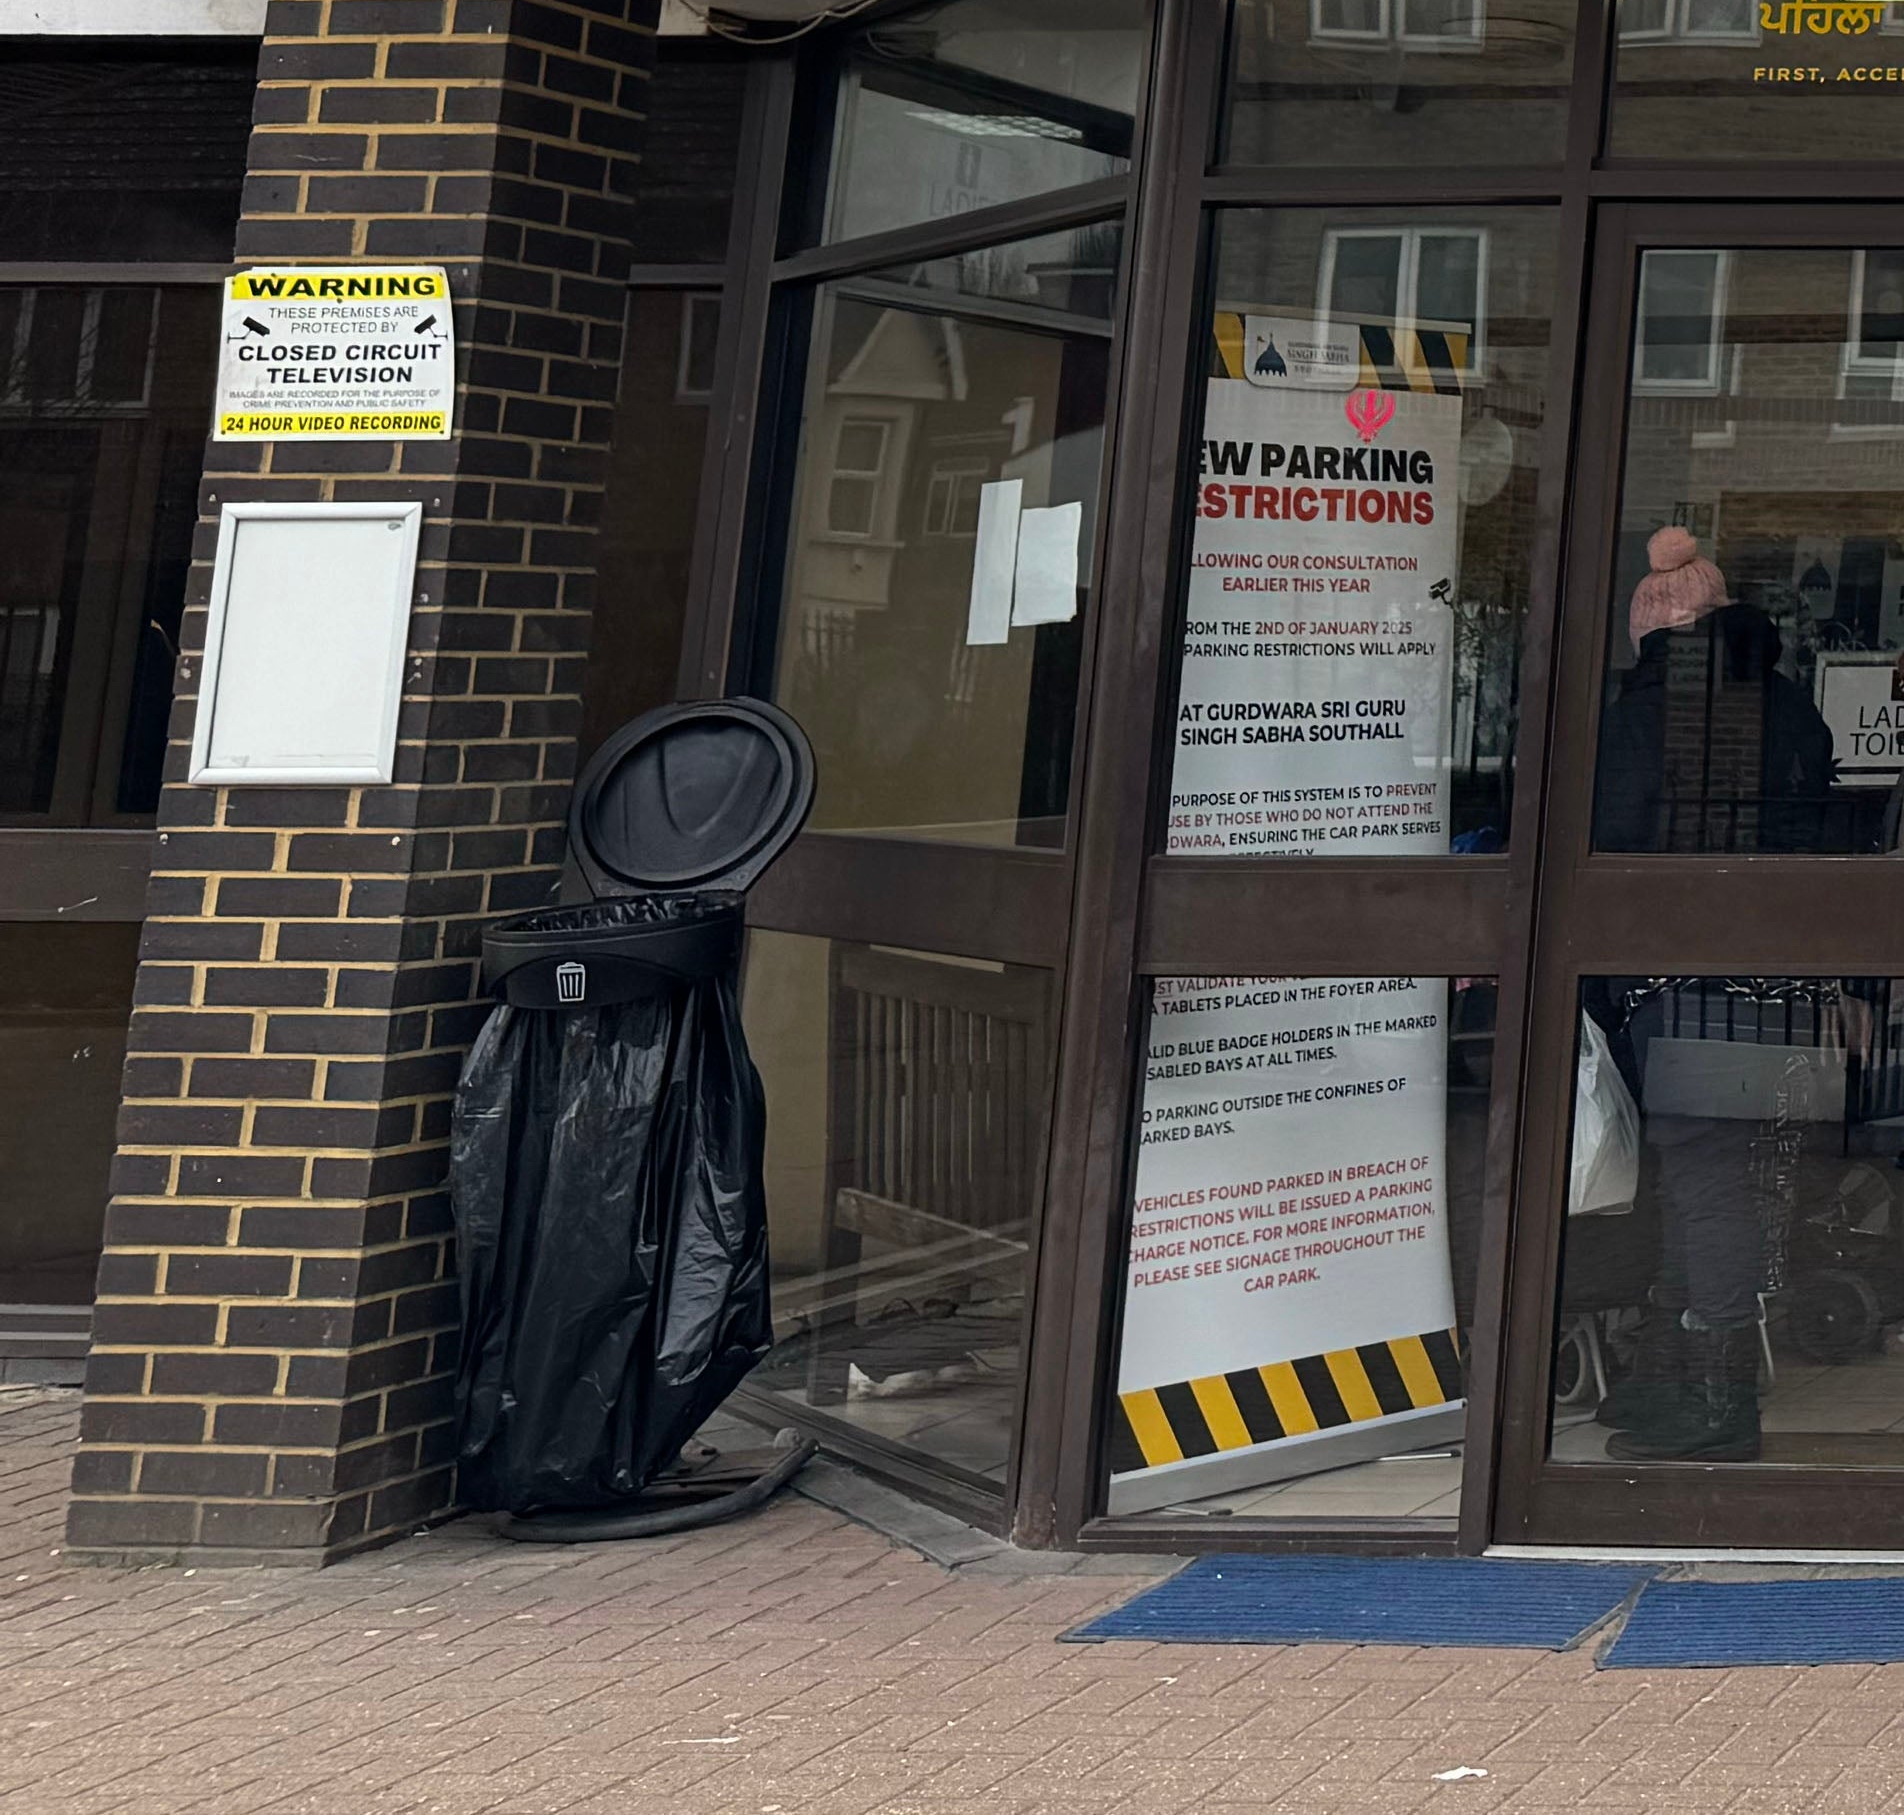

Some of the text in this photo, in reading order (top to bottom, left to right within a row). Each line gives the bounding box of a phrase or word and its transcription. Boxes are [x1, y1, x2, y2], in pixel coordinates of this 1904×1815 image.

[1753, 67, 1826, 84] FIRST,
[247, 276, 436, 297] WARNING
[268, 306, 419, 319] THESE PREMISES ARE
[290, 321, 400, 334] PROTECTED BY
[237, 344, 442, 361] CLOSED CIRCUIT
[266, 366, 413, 384] TELEVISION
[226, 415, 442, 431] 24 HOUR VIDEO RECORDING
[1260, 442, 1435, 484] PARKING
[1266, 554, 1418, 571] OUR CONSULTATION
[1222, 576, 1371, 593] EARLIER THIS YEAR
[1221, 620, 1252, 635] THE
[1254, 620, 1285, 635] 2ND
[1287, 620, 1307, 635] OF
[1309, 620, 1379, 635] JANUARY
[1183, 641, 1437, 658] PARKING RESTRICTIONS WILL APPLY
[1179, 699, 1406, 722] AT GURDWARA SRI GURU
[1180, 722, 1405, 746] SINGH SABHA SOUTHALL
[1134, 1156, 1430, 1214] VEHICLES FOUND PARKED IN BREACH OF
